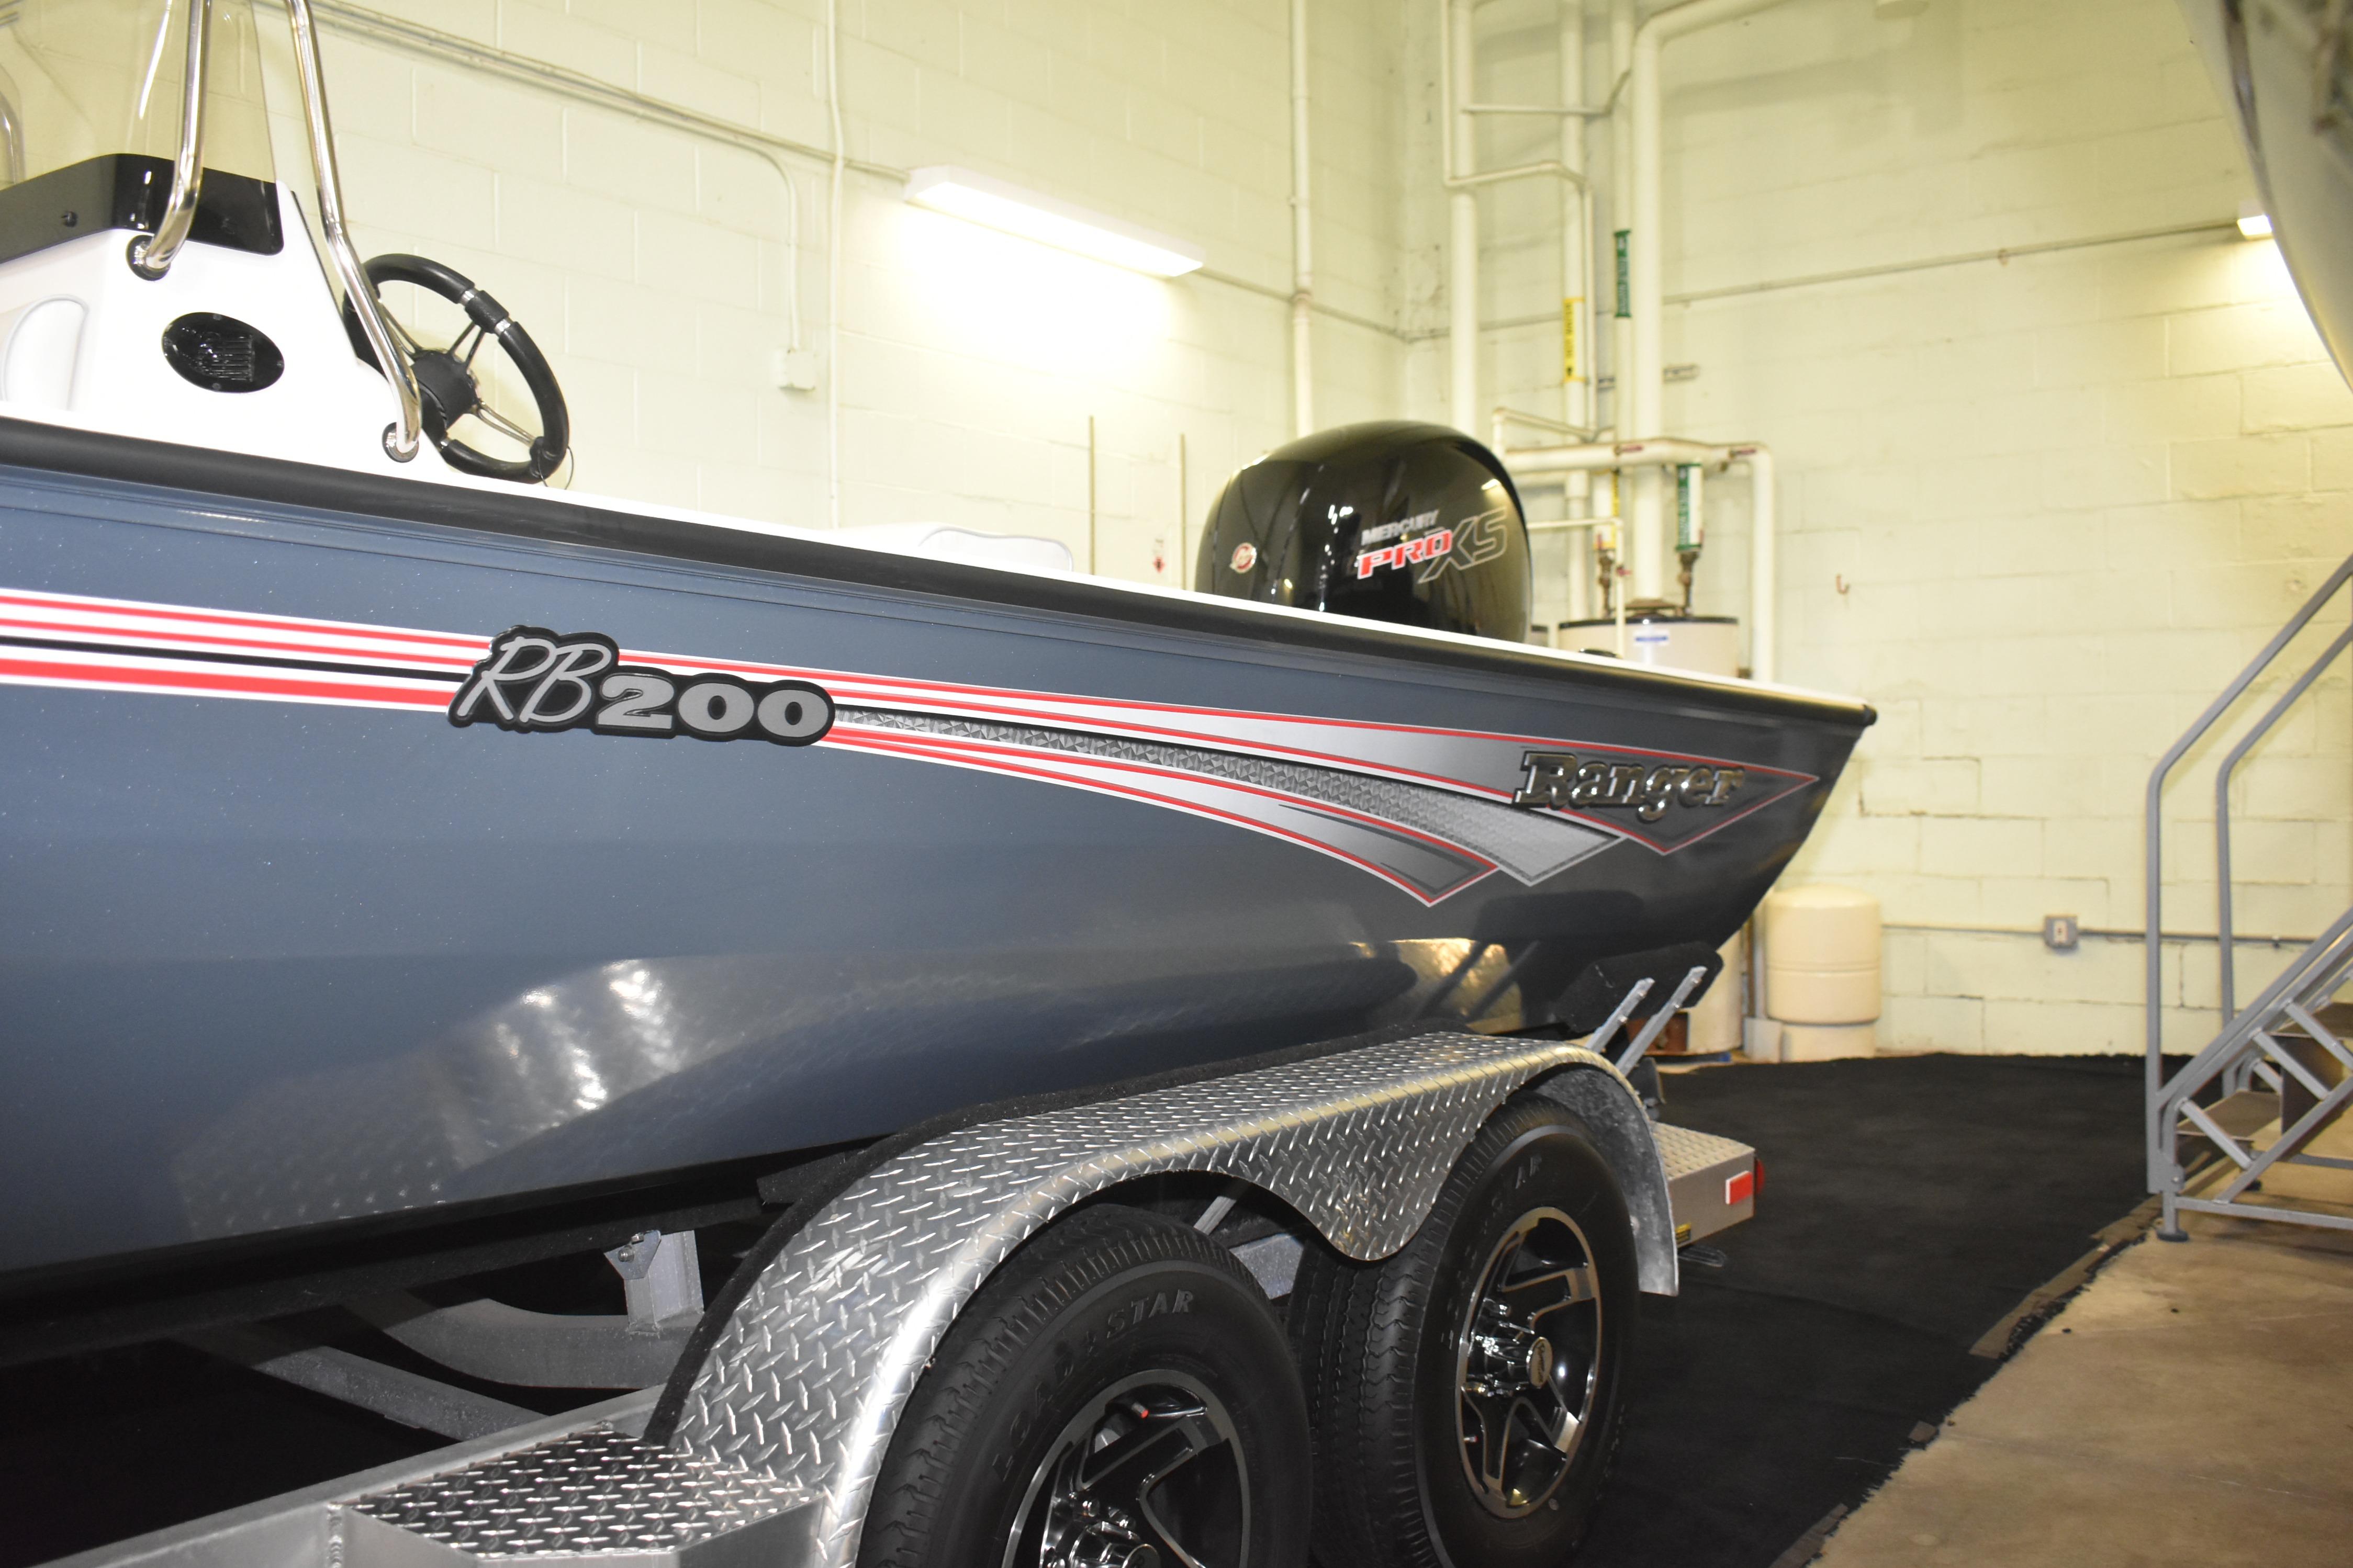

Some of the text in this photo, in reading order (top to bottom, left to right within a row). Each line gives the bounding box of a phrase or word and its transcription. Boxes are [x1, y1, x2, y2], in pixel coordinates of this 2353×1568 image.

[1357, 505, 1508, 584] PRO XS
[1361, 510, 1439, 546] MERCURY
[1514, 750, 1746, 825] Ranger
[1106, 1289, 1194, 1339] STAR
